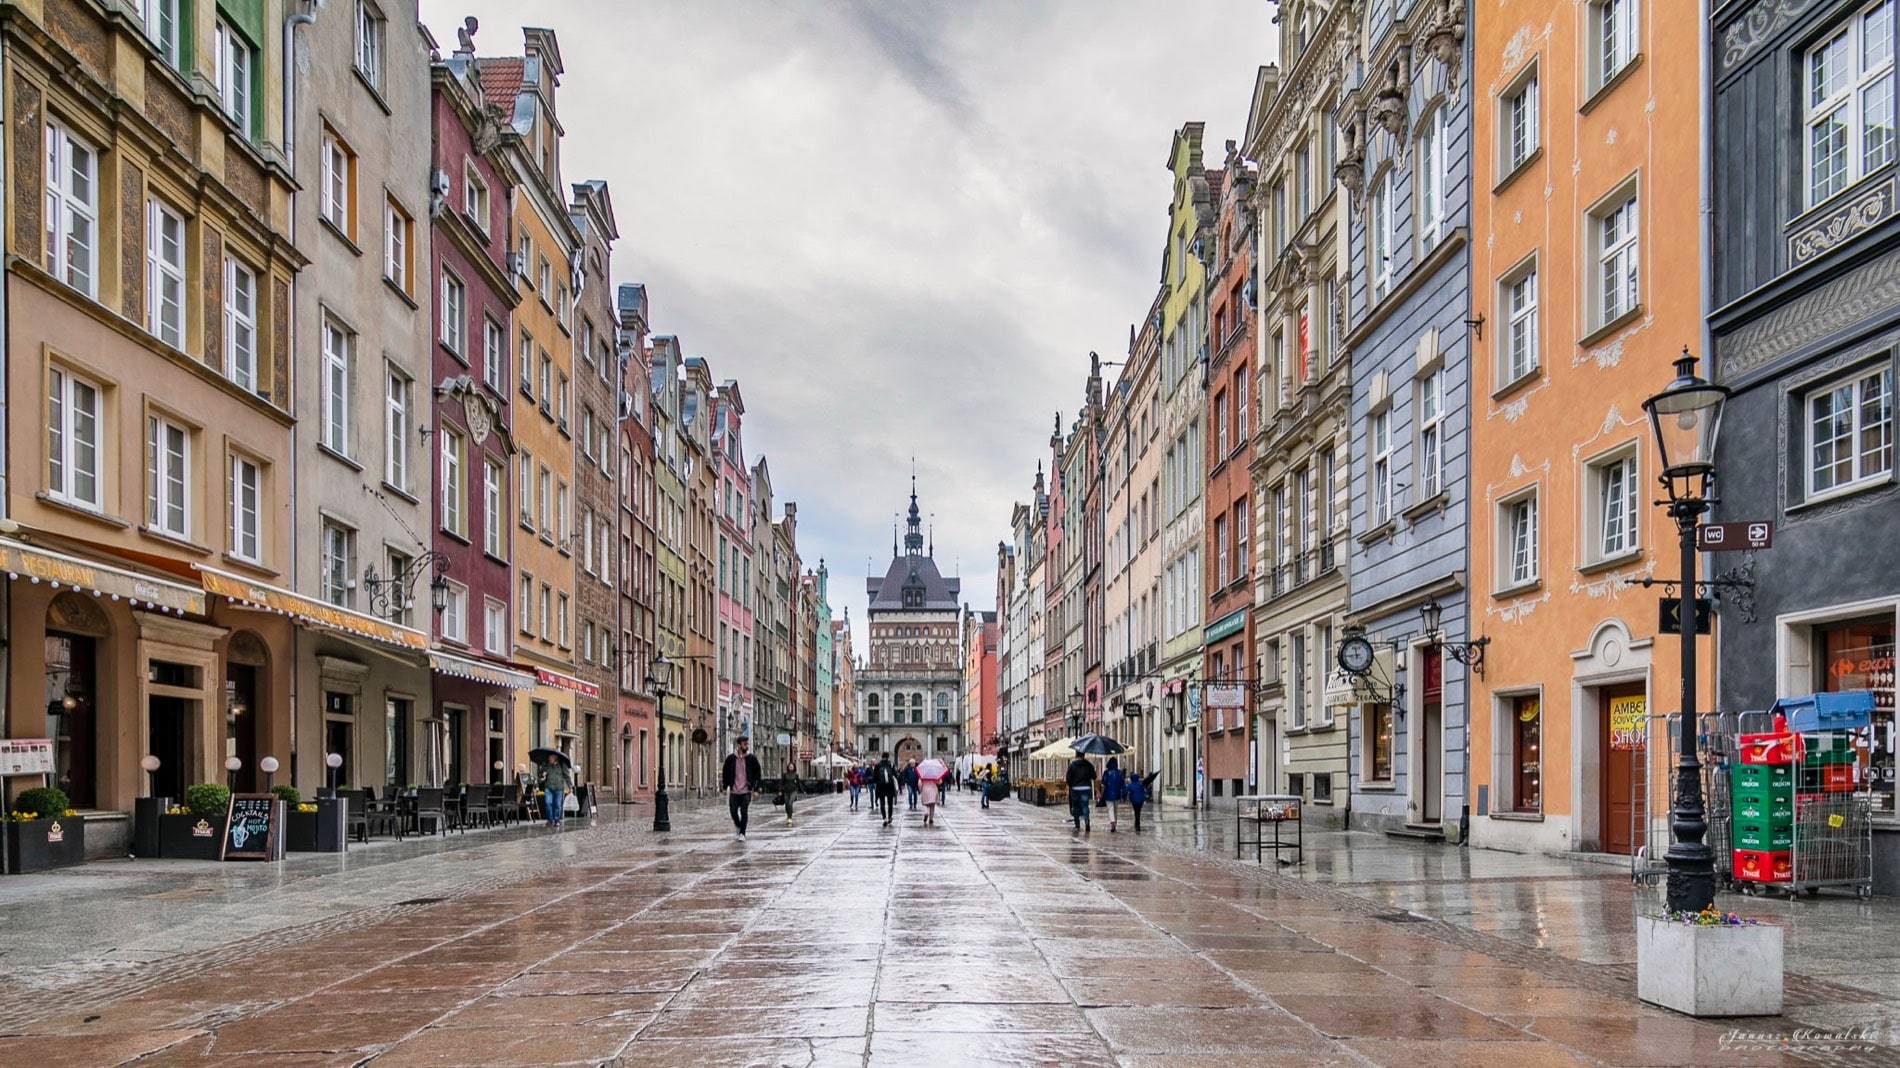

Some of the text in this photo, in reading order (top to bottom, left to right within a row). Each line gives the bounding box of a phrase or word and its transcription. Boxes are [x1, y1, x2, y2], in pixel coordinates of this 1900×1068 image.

[1707, 531, 1721, 539] WC
[21, 553, 95, 586] RESTAURANT
[231, 810, 269, 822] COCKTAILS
[247, 824, 268, 834] MOJITO
